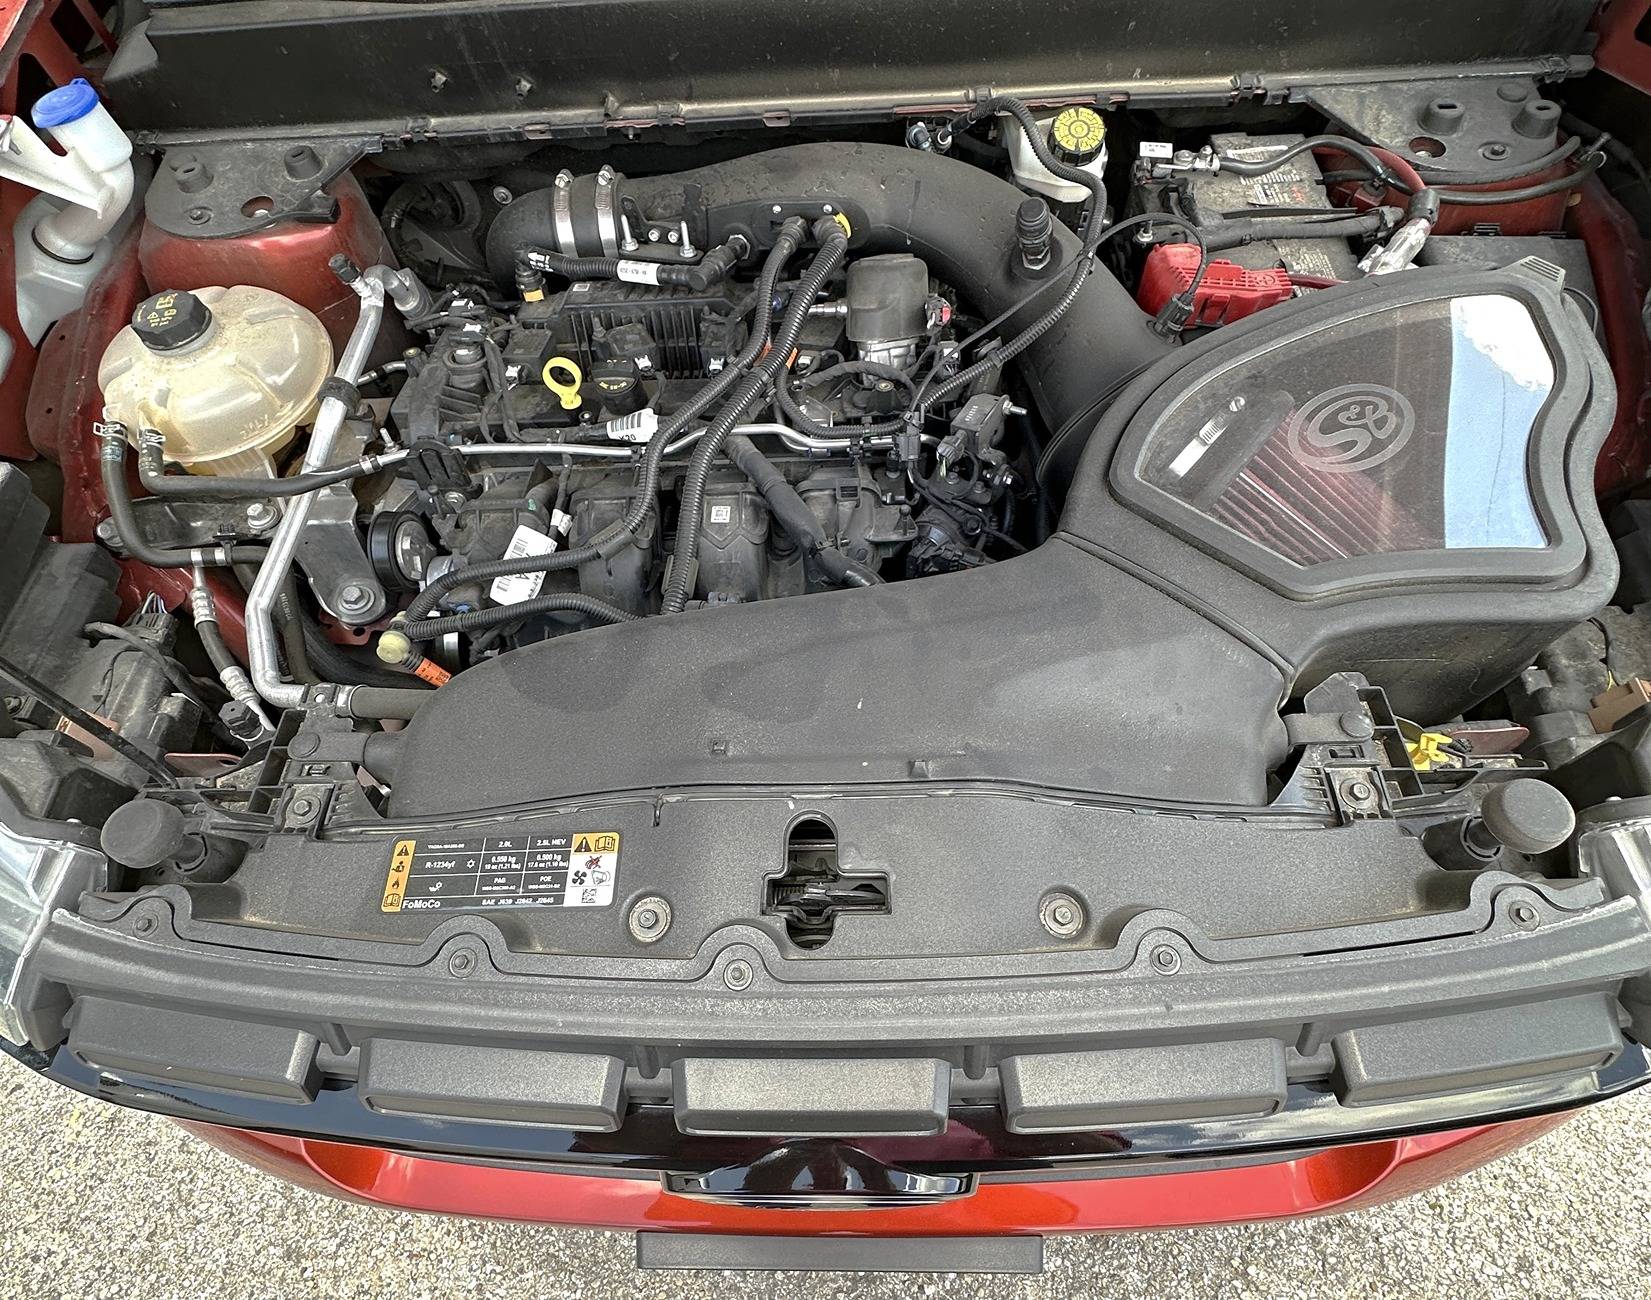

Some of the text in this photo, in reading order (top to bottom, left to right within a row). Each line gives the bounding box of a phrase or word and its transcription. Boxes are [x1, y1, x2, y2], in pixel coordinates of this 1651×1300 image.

[551, 838, 567, 846] HEV
[508, 856, 517, 864] kg
[553, 854, 562, 862] kg
[425, 860, 456, 869] R-1234yf
[402, 899, 441, 909] FoMoCo
